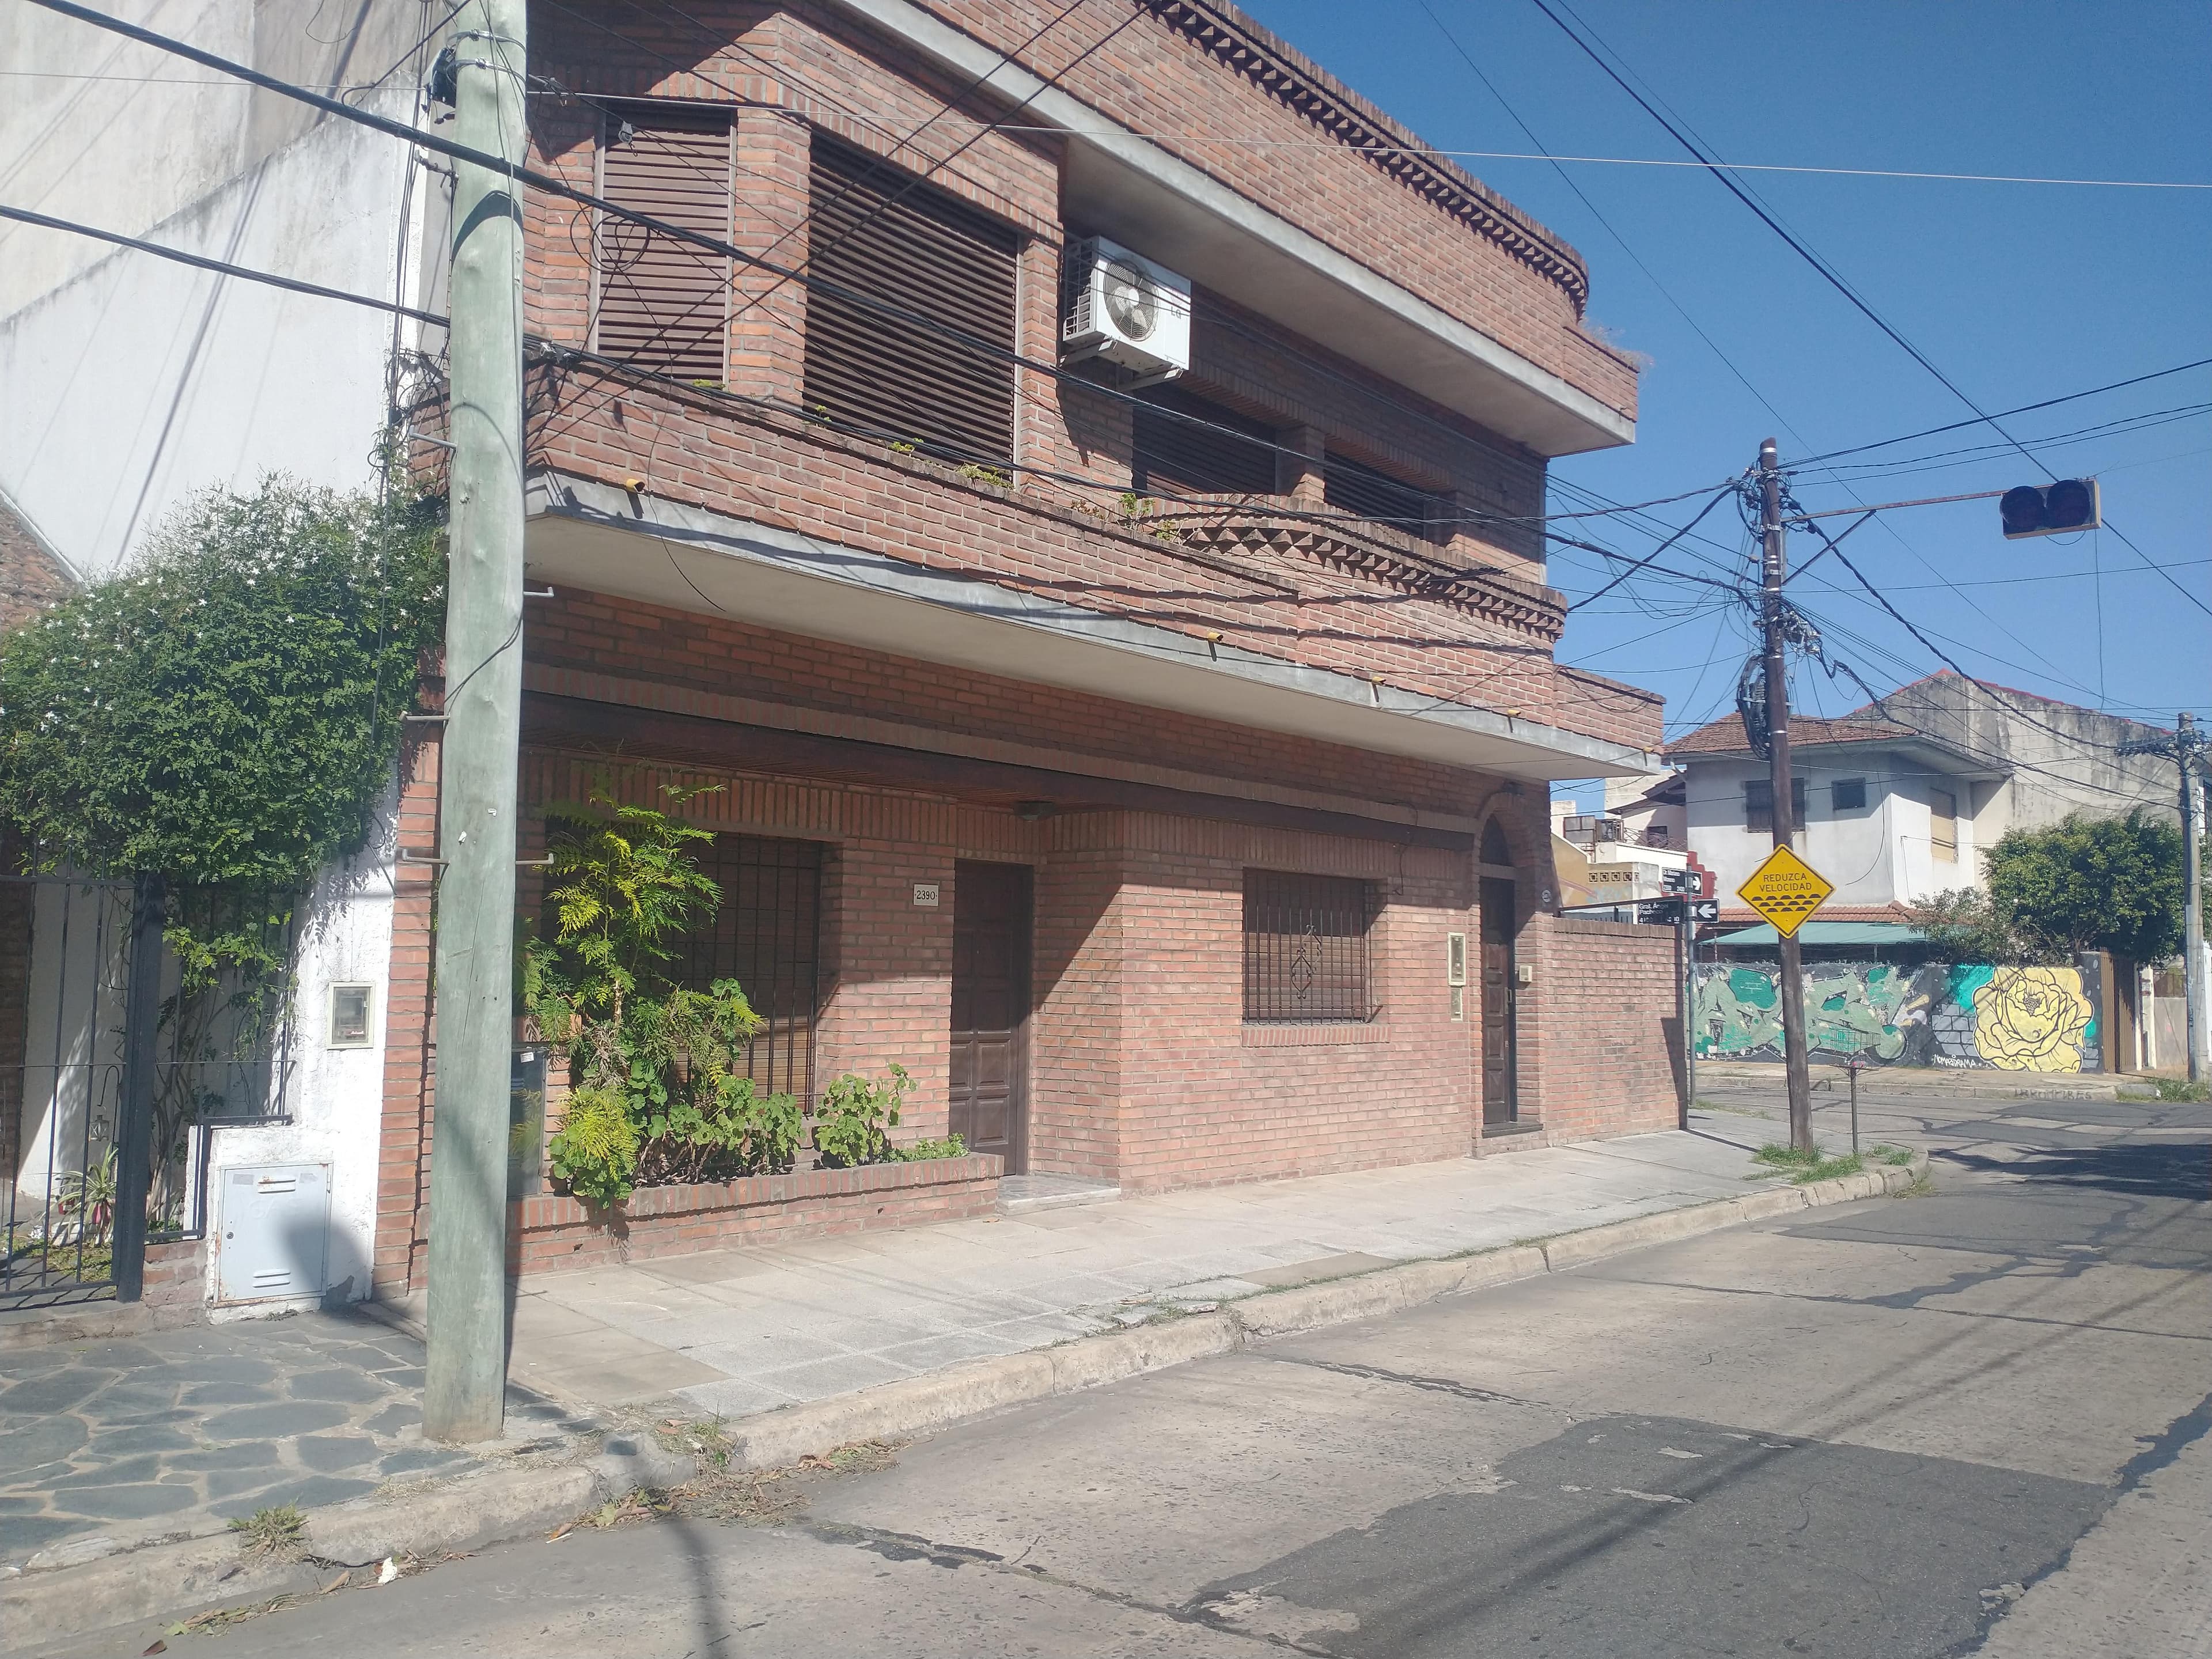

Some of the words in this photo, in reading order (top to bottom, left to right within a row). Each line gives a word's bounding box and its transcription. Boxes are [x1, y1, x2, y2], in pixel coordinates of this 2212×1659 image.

[1763, 873, 1807, 882] REDUZCA
[1759, 882, 1812, 892] VELOCIDAD
[916, 890, 935, 900] 2390
